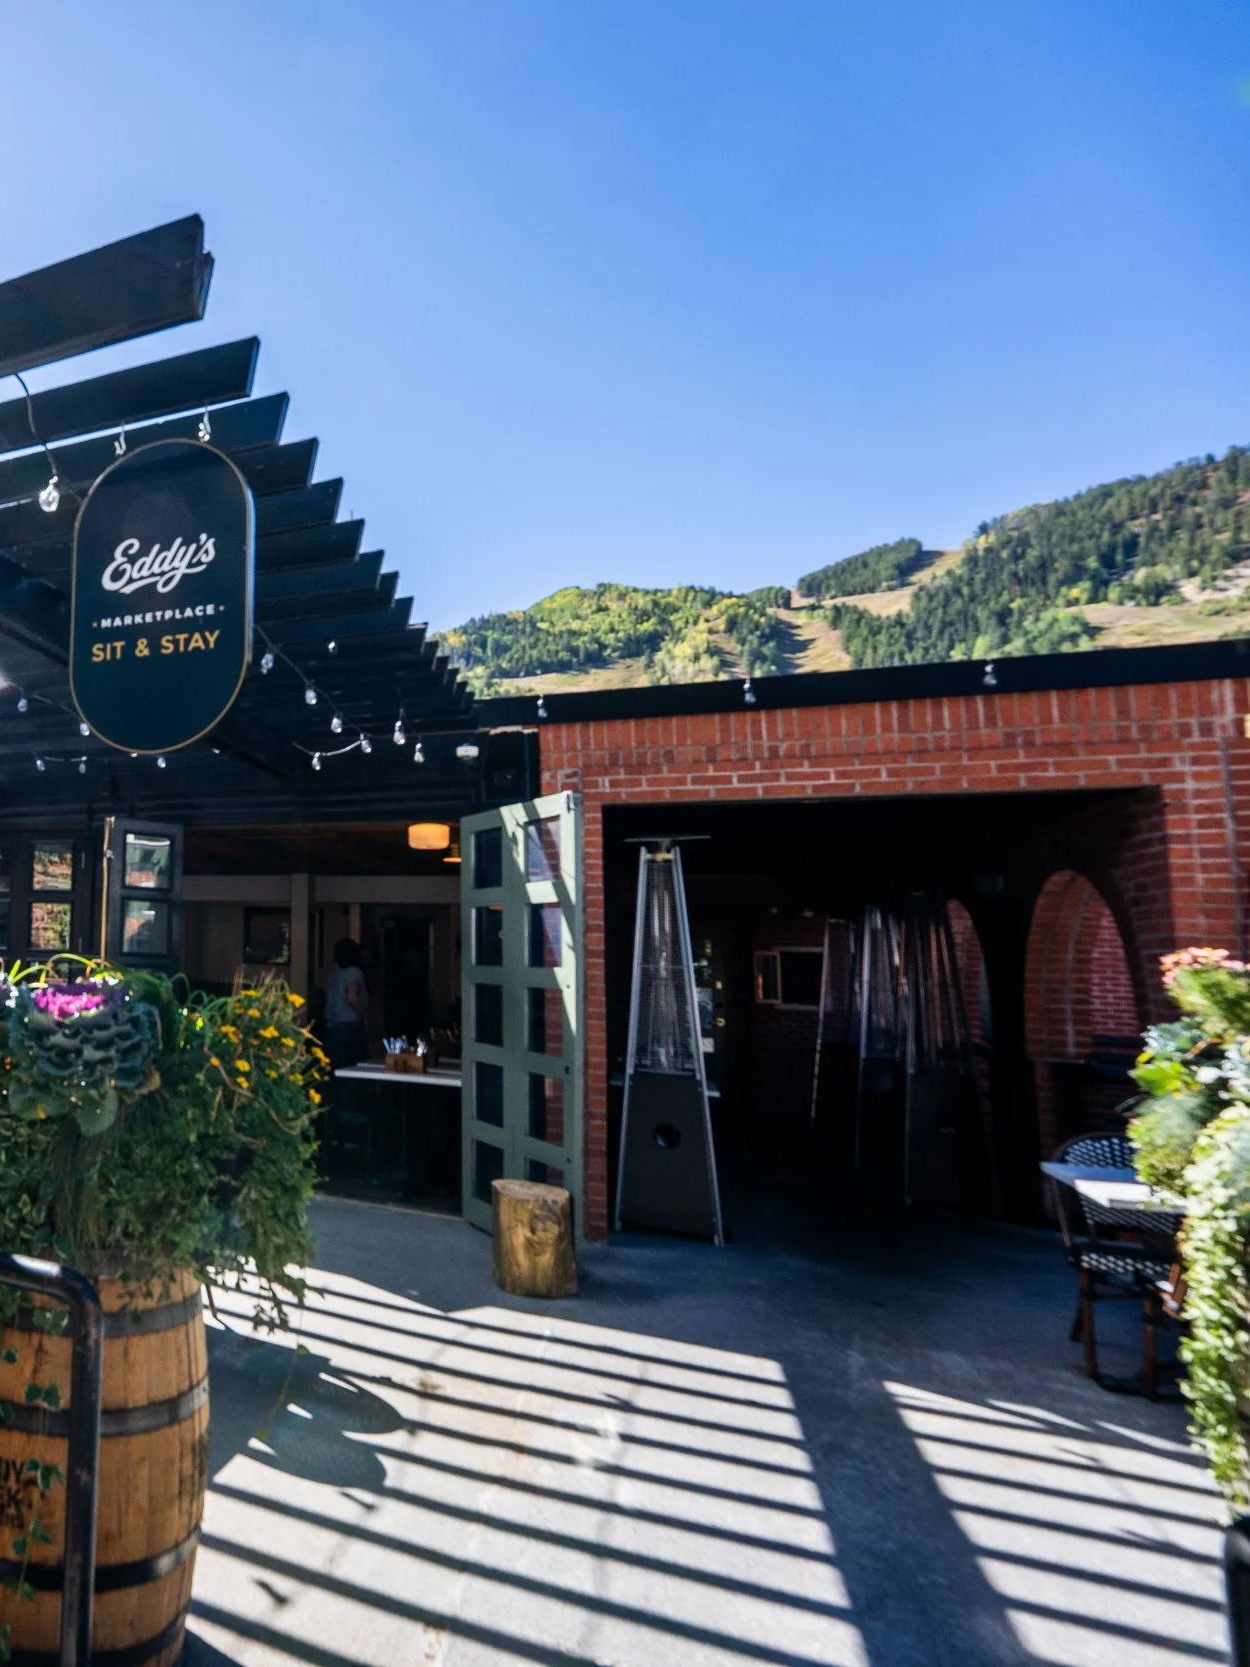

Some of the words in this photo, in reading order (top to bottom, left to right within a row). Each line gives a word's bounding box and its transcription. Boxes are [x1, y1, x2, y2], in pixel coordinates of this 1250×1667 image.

[101, 532, 216, 594] Eddy's
[100, 603, 216, 629] MARKETPLACE
[91, 641, 126, 662] SIT
[134, 638, 150, 657] &
[160, 629, 220, 655] STAY
